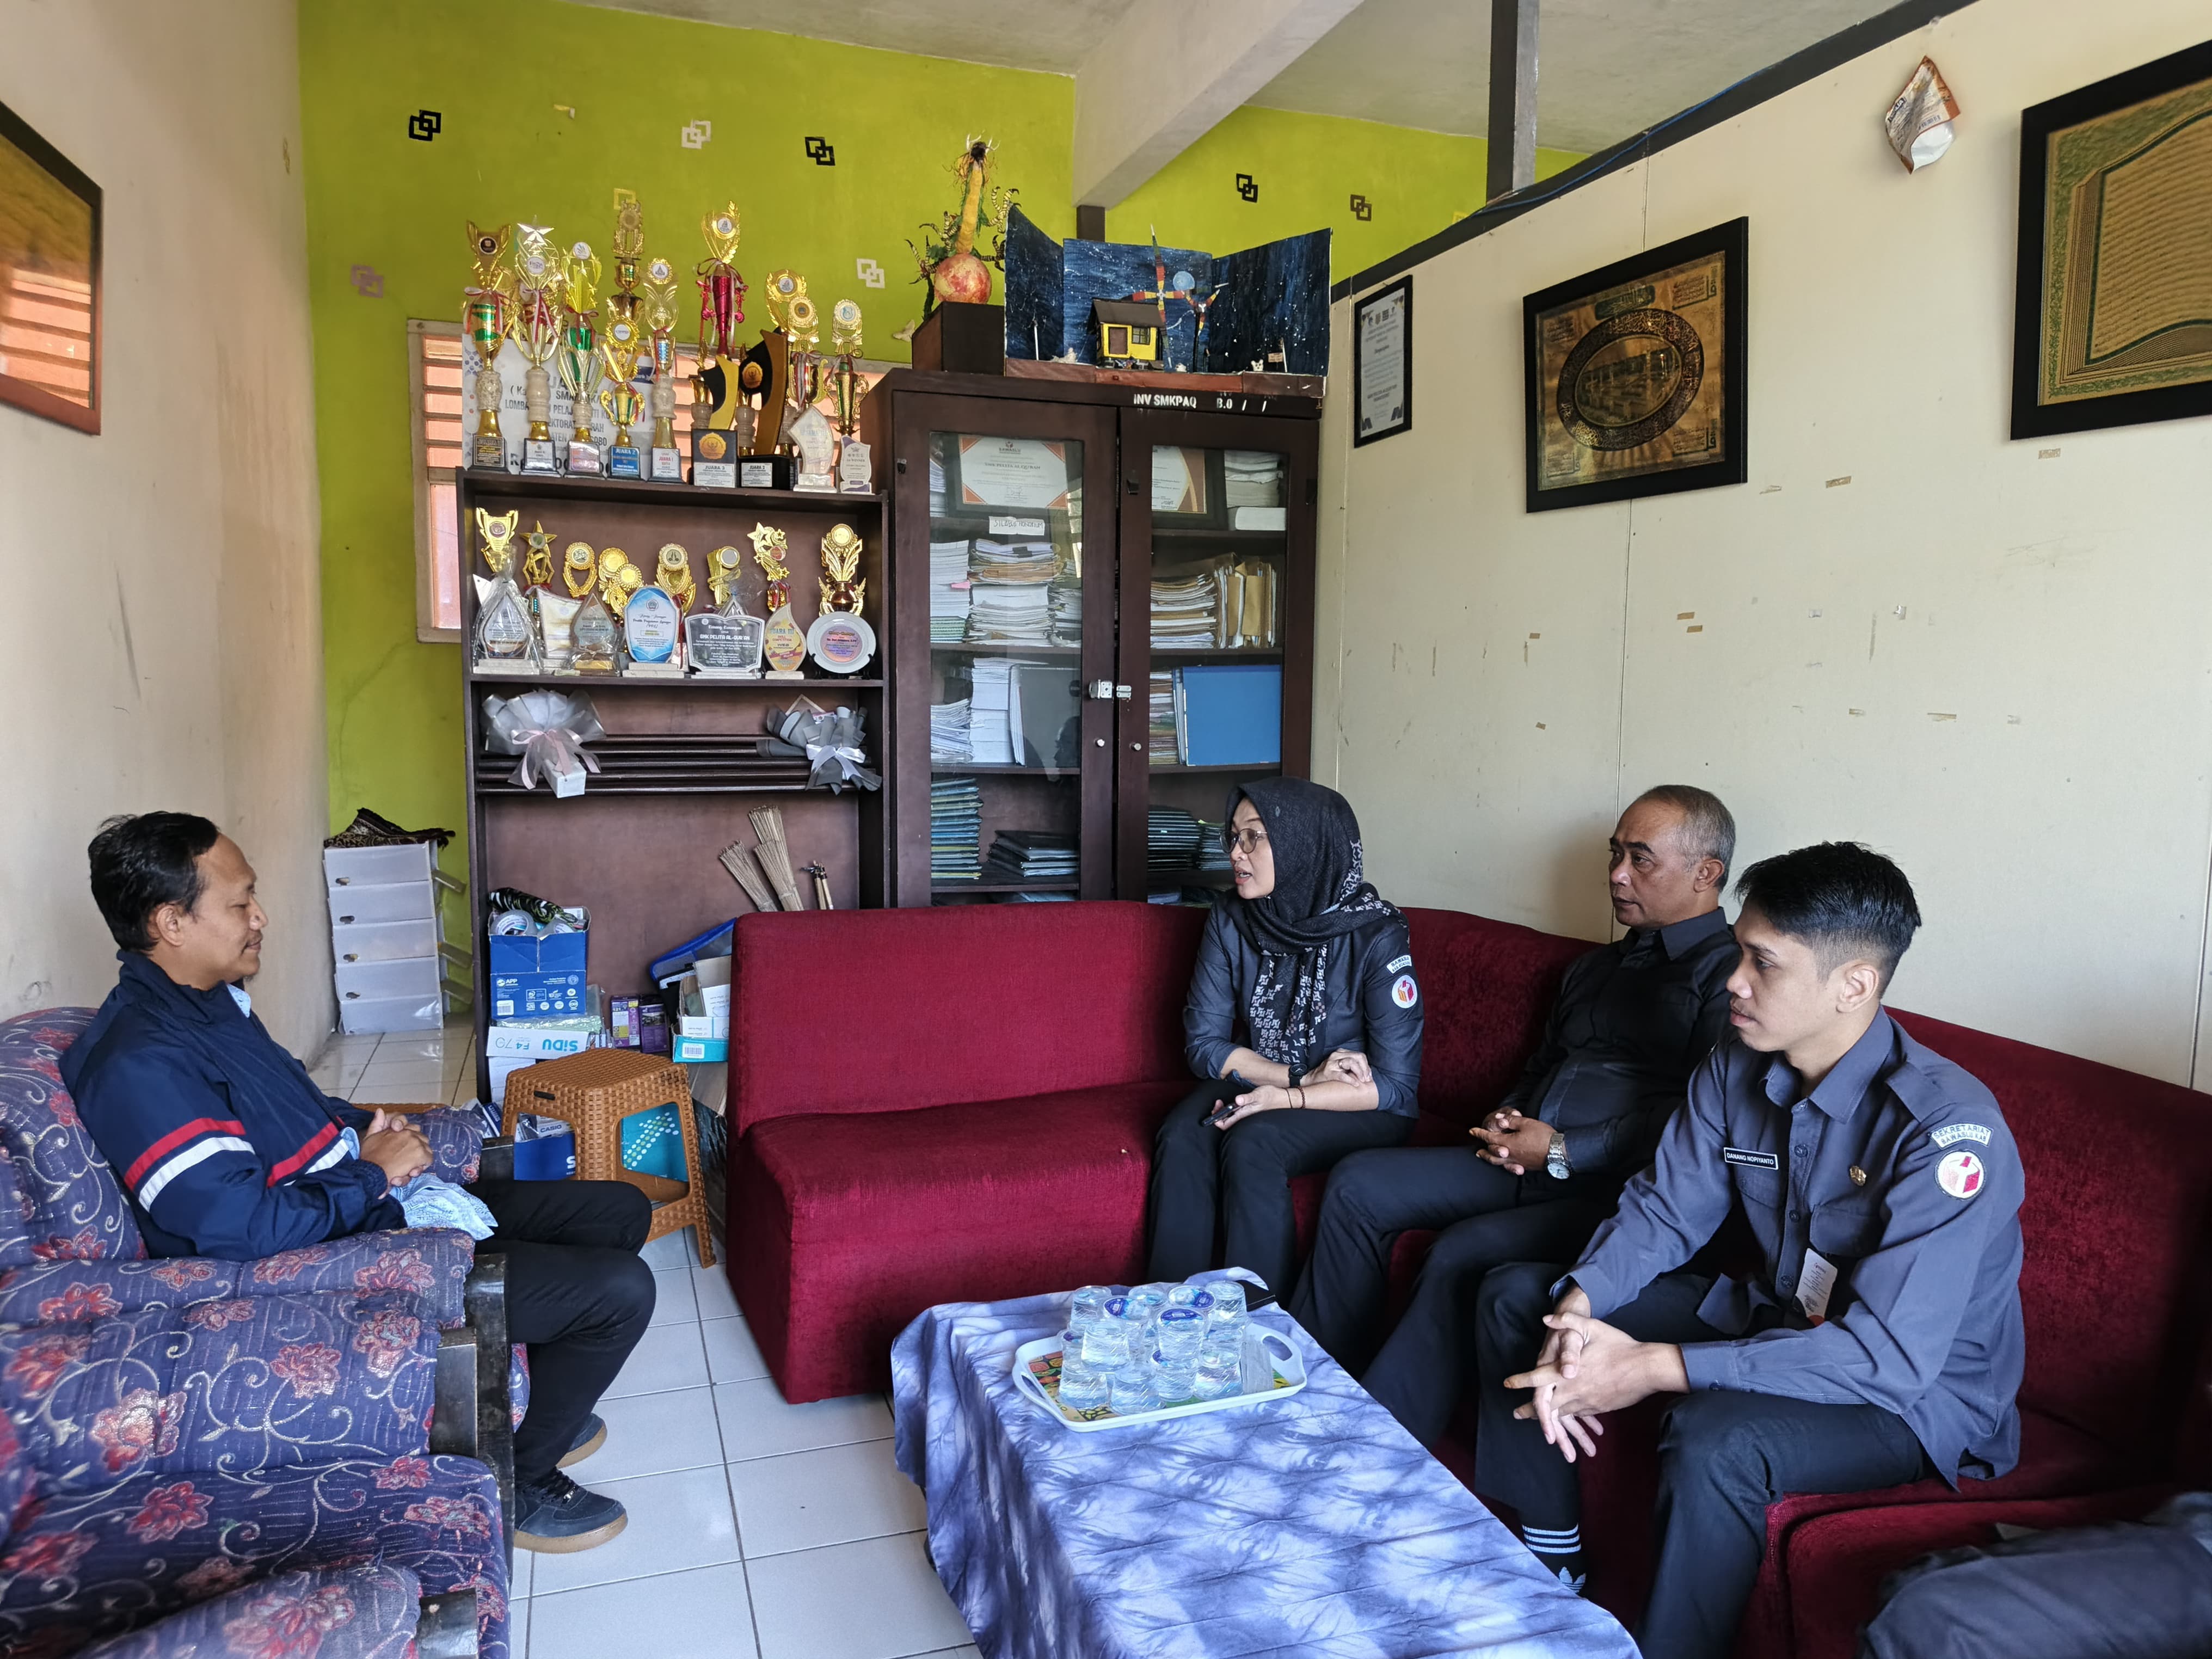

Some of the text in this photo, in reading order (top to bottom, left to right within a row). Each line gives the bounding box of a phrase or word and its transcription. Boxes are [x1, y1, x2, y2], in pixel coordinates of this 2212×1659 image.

[1134, 394, 1152, 405] INV
[1153, 395, 1197, 408] SMKPAQ
[553, 404, 573, 415] PELAJ
[540, 1125, 562, 1133] CASIO
[1933, 1125, 1989, 1139] SEKRETARIAT
[1940, 1132, 1986, 1144] BAWASLU KAB
[1726, 1153, 1774, 1165] DANANG NOPIYANTO
